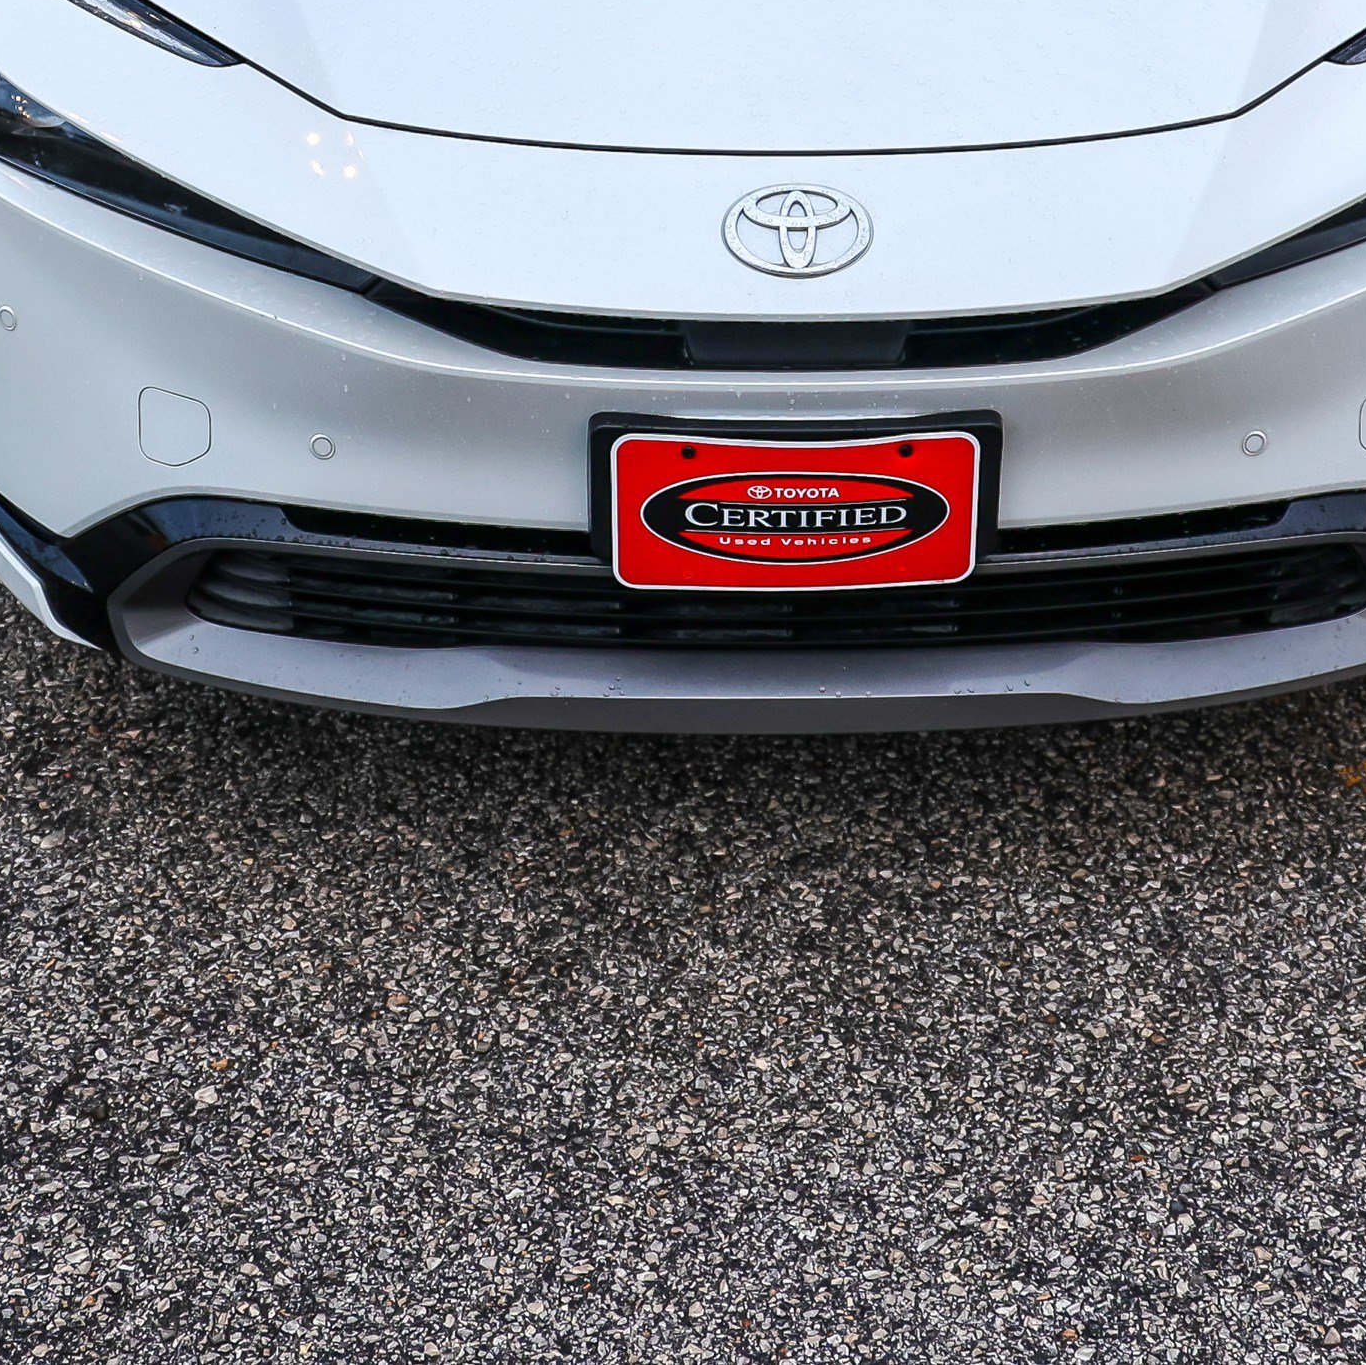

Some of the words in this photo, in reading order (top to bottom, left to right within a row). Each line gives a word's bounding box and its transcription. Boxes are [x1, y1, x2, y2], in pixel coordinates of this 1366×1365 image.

[774, 487, 840, 499] TOYOTA
[685, 502, 907, 528] CERTIFIED
[719, 536, 771, 546] Used
[780, 536, 872, 546] Vehicles
